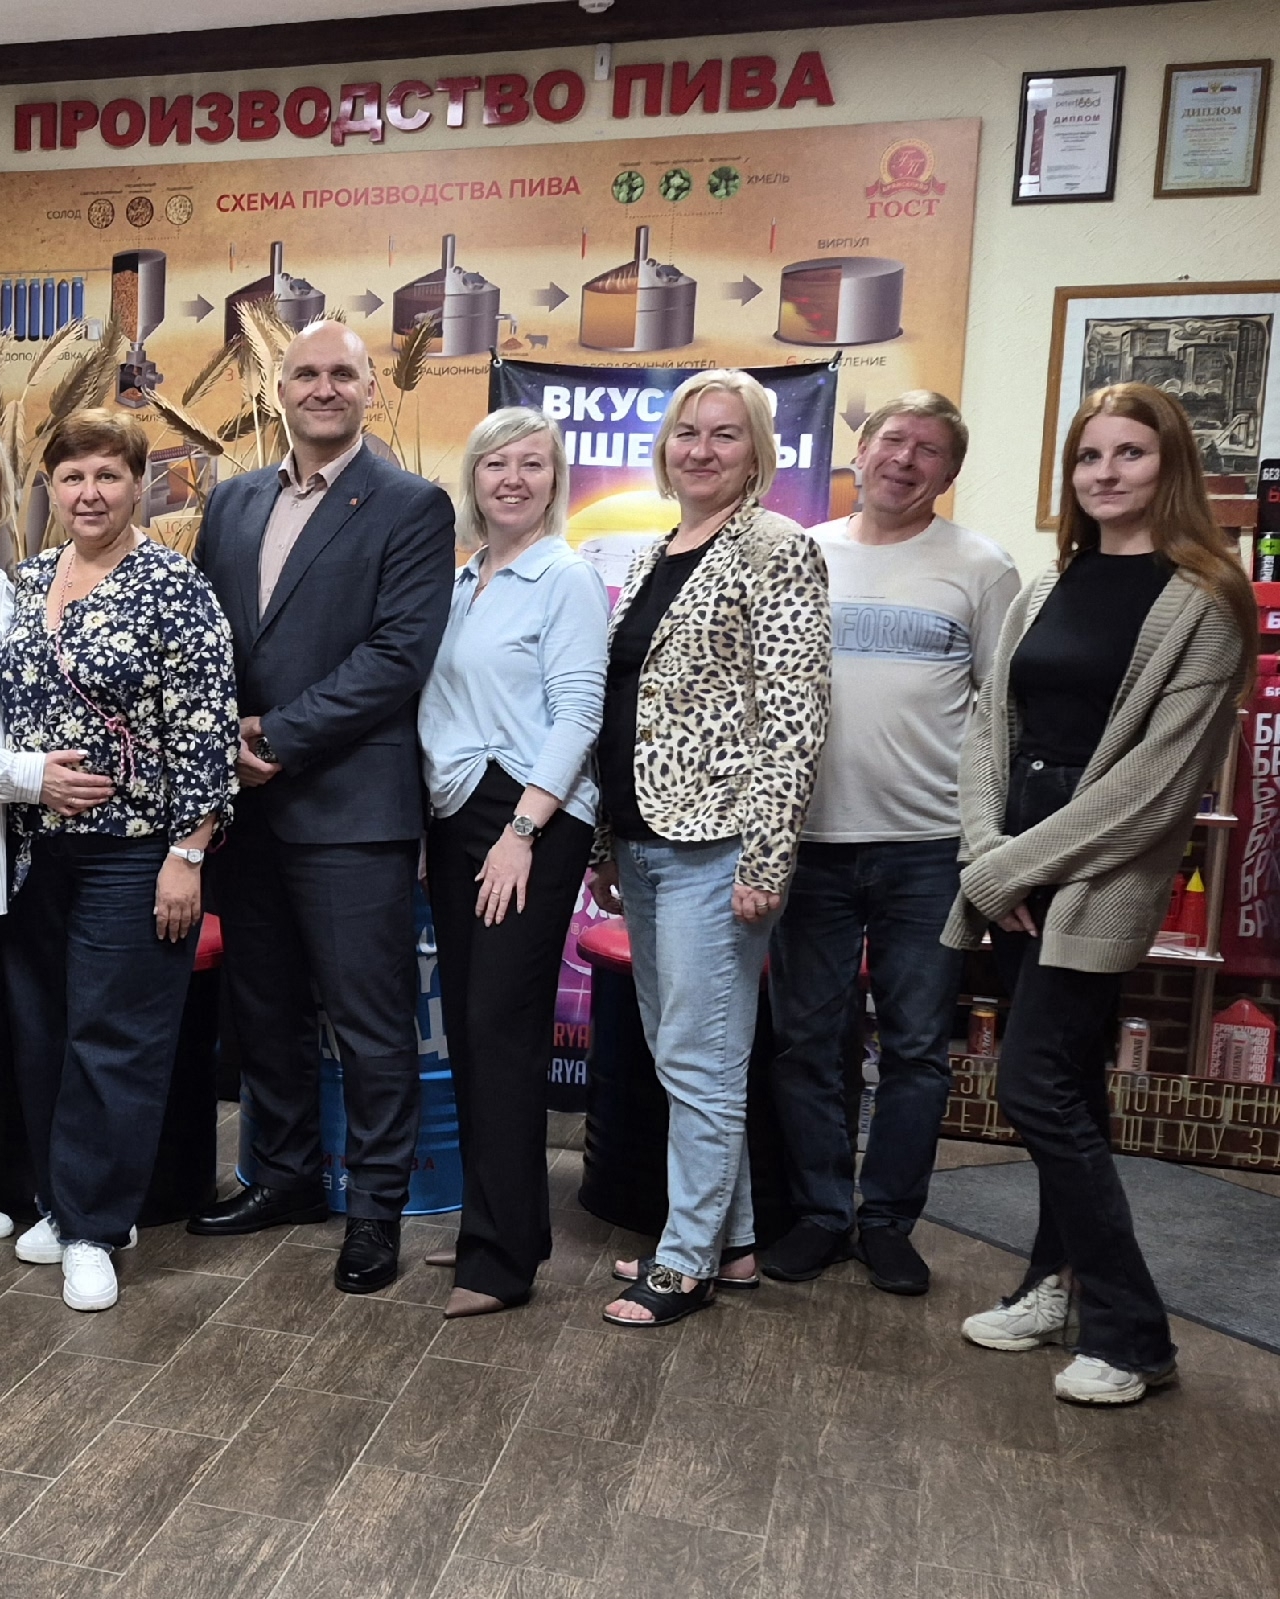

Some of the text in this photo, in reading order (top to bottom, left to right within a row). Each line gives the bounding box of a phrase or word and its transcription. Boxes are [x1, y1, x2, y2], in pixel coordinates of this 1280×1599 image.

[15, 50, 836, 151] ПРОИЗВОДСТВО ПИВА
[1182, 106, 1241, 118] ДИПЛОМ
[1053, 114, 1100, 125] ДИПЛОМ
[746, 173, 790, 185] ХМЕЛЬ
[216, 176, 582, 213] СХЕМА ПРОИЗВОДСТВА ПИВА
[46, 209, 82, 220] СОЛОД
[867, 199, 940, 219] ГОСТ
[818, 237, 870, 249] ВИРПУЛ
